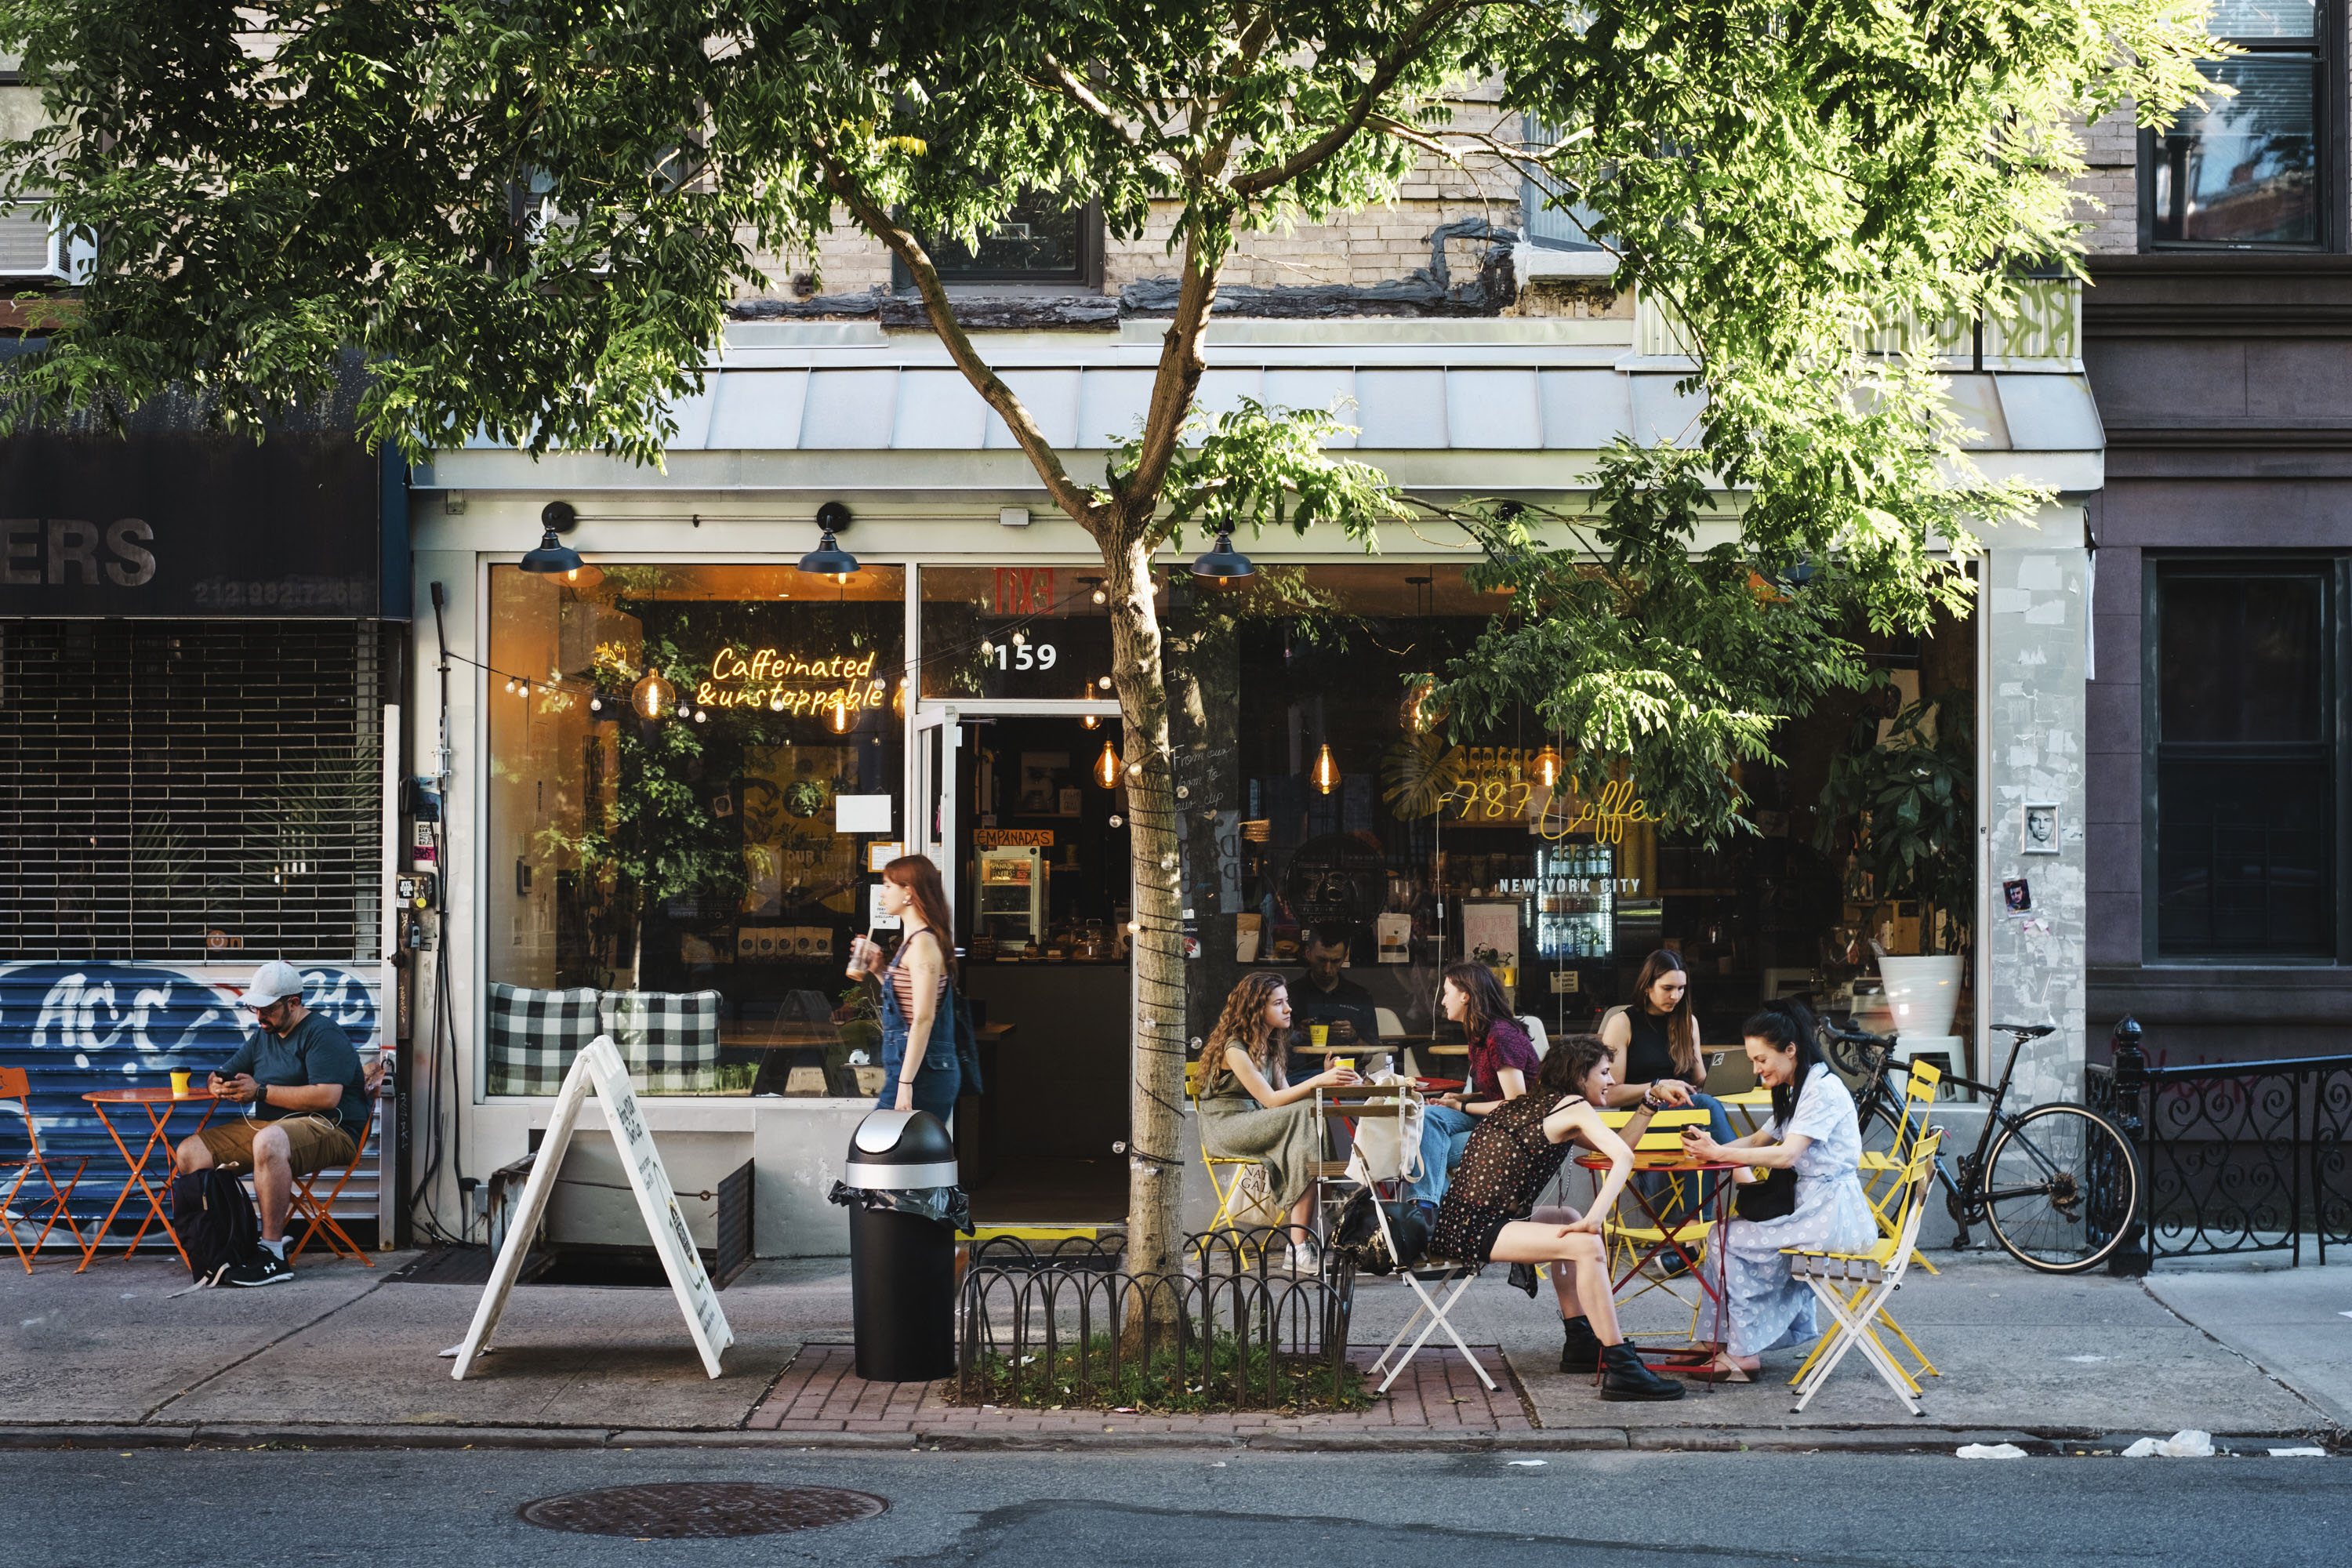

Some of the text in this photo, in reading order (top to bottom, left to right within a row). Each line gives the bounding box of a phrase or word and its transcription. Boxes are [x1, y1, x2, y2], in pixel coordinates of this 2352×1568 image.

[0, 517, 157, 586] ERS
[713, 647, 876, 681] Caffeinated
[994, 644, 1058, 671] 159
[1174, 744, 1203, 771] From
[1206, 765, 1222, 781] to
[1203, 791, 1224, 807] cup
[1455, 775, 1667, 845] 787 Coffe
[977, 829, 1051, 847] EMPANADAS
[1498, 878, 1641, 894] NEW YORK CITY
[1241, 1178, 1272, 1195] GAL
